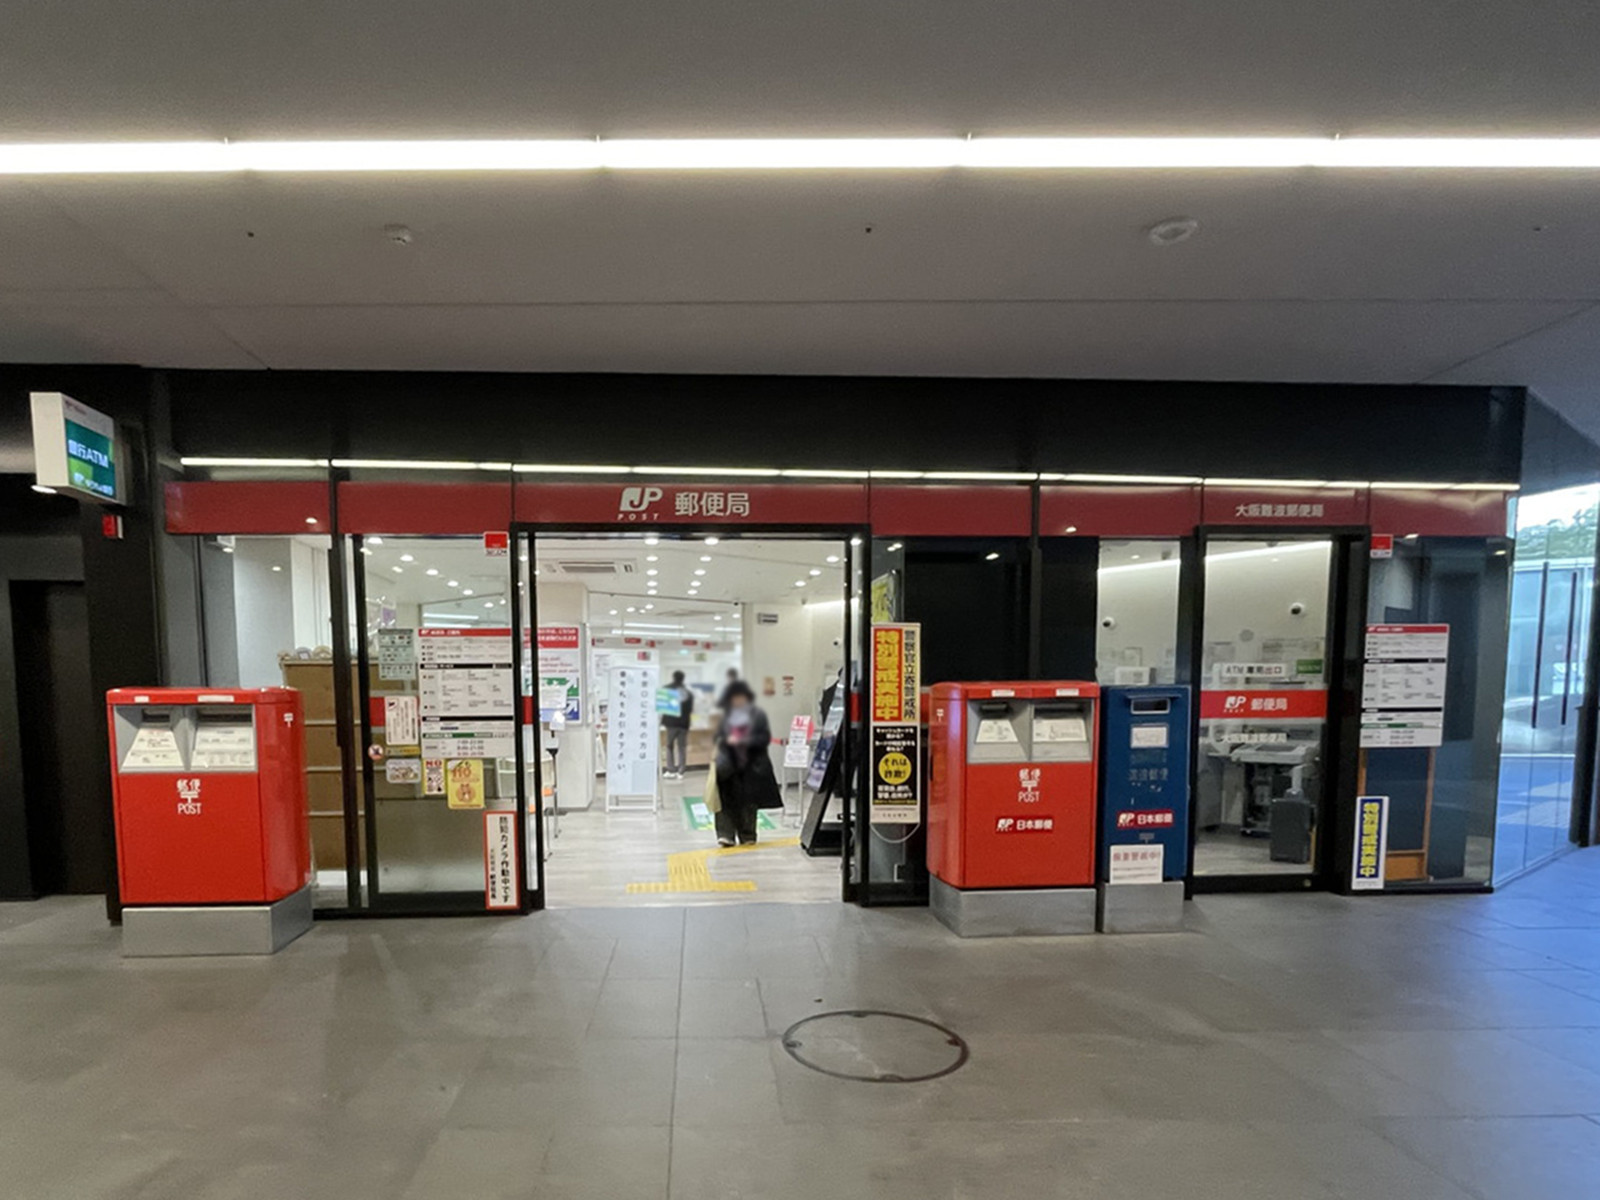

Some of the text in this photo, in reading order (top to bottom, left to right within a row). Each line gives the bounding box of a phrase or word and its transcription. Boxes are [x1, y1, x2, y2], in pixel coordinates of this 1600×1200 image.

[619, 487, 750, 517] JP 郵便局
[1235, 504, 1325, 517] 大阪難波郵便局
[617, 513, 660, 521] POST
[1251, 698, 1288, 711] 郵便局
[1019, 768, 1041, 781] 郵便
[176, 779, 201, 793] 郵便
[1018, 791, 1040, 803] POST
[177, 803, 202, 815] POST
[1016, 819, 1053, 831] 日本郵便
[1137, 813, 1173, 825] 日本郵便
